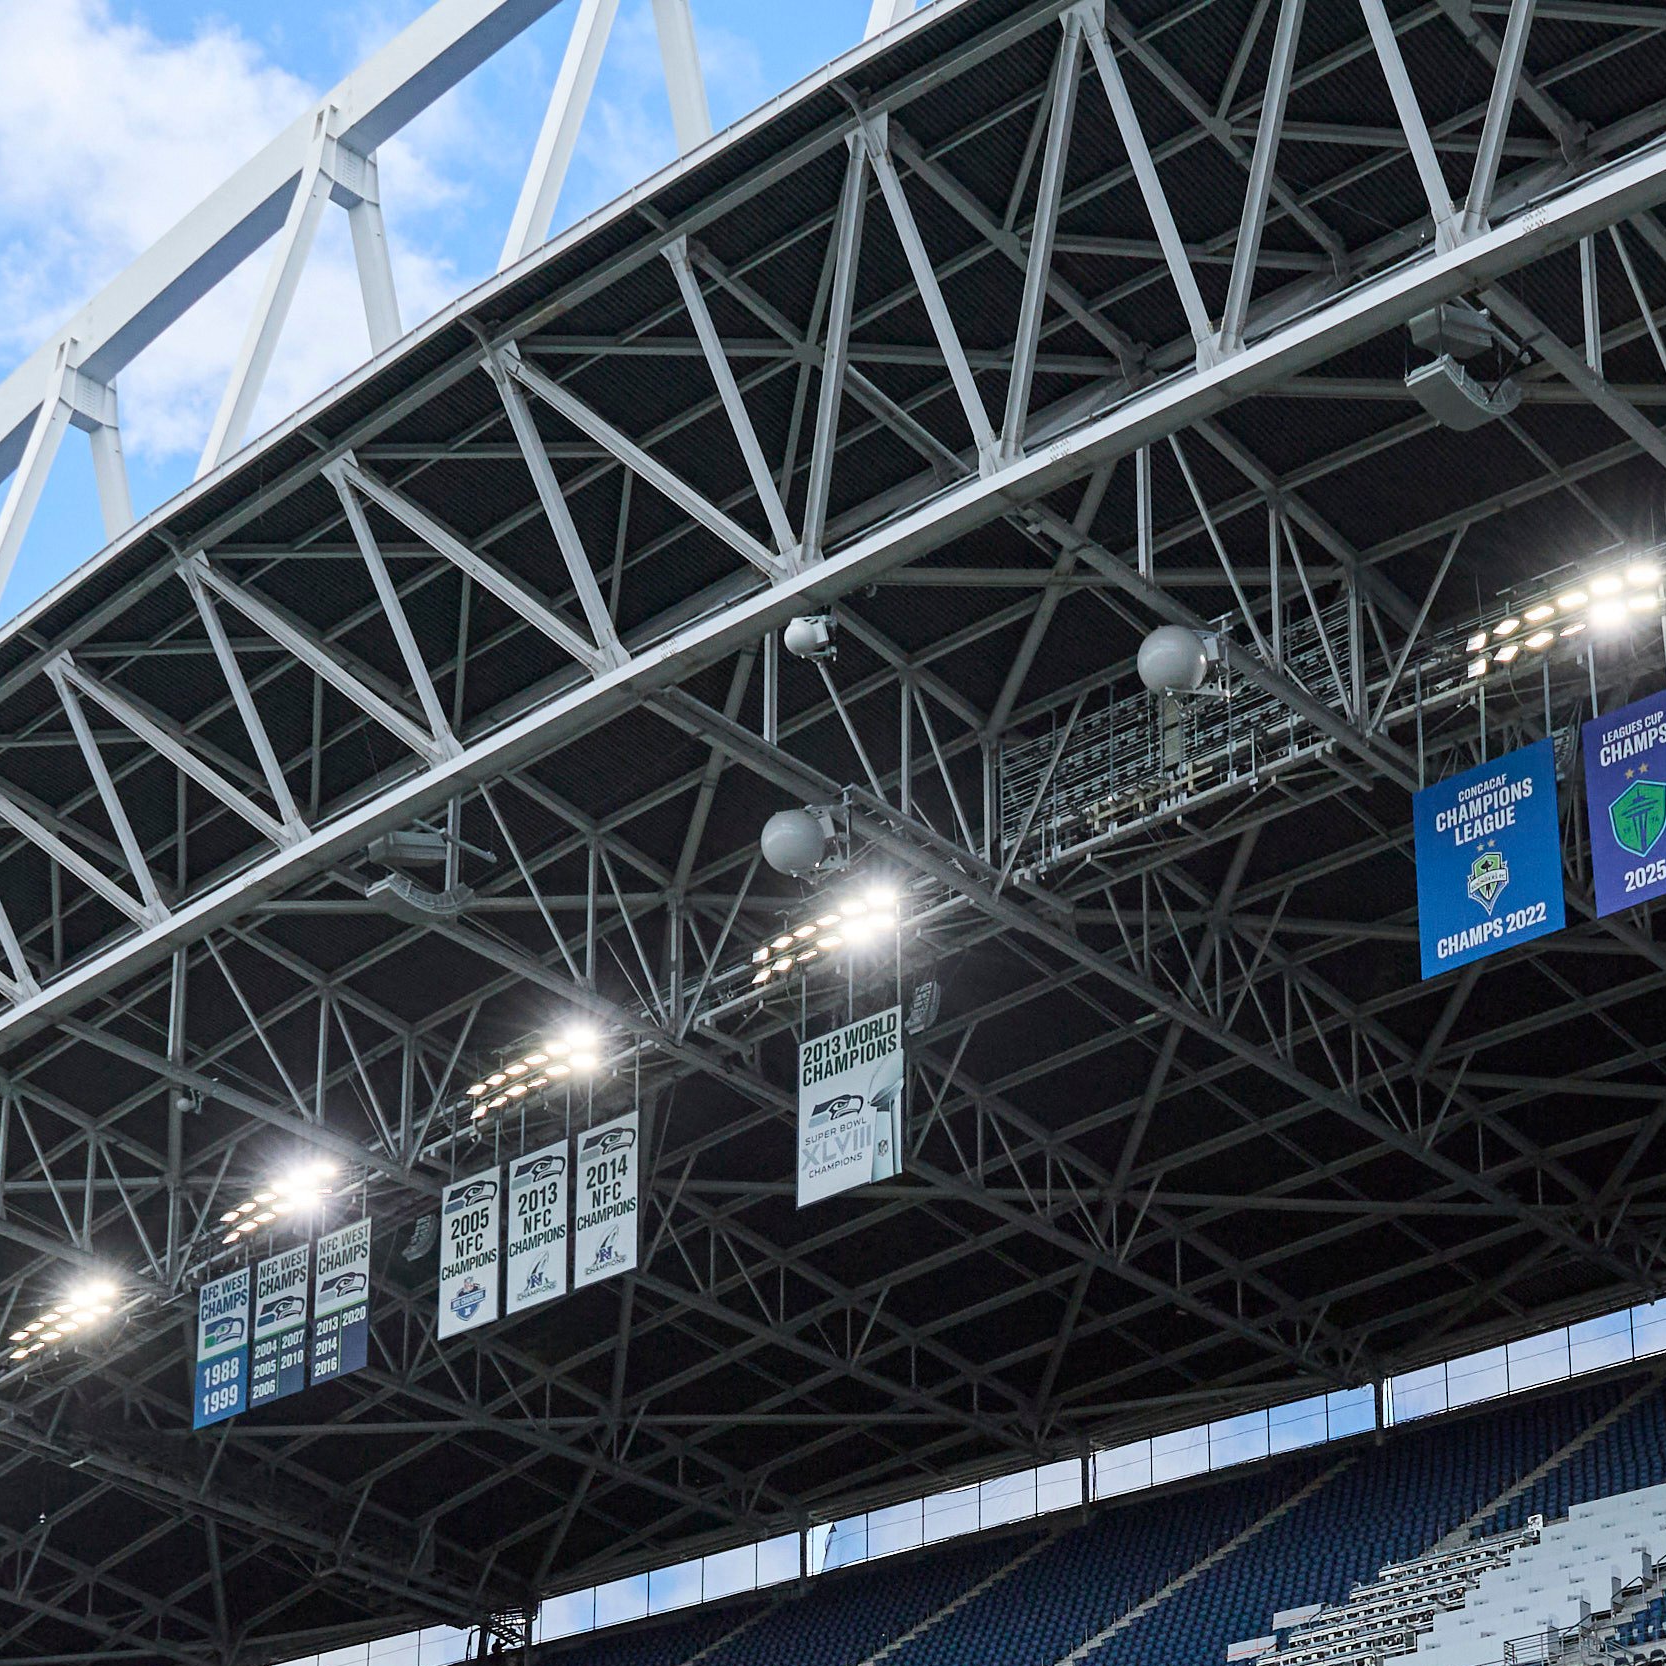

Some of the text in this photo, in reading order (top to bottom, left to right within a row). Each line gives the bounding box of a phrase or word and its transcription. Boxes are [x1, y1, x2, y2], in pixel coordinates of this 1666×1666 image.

[1602, 710, 1664, 746] LEAGUES CUP
[1458, 773, 1507, 802] CONCACAF
[1435, 777, 1533, 833] CHAMPIONS
[1454, 806, 1515, 847] LEAGUE
[1624, 859, 1666, 893] 2025
[1436, 902, 1547, 959] CHAMPS 2022
[803, 1012, 897, 1067] 2013 WORLD
[803, 1034, 897, 1087] CHAMPIONS
[805, 1117, 867, 1146] SUPER BOWL
[801, 1125, 872, 1172] XLVIII
[586, 1154, 628, 1190] 2014
[809, 1152, 863, 1179] CHAMPIONS
[518, 1182, 558, 1216] 2013
[592, 1181, 621, 1208] NFC
[451, 1207, 489, 1241] 2005
[523, 1208, 551, 1235] NFC
[577, 1197, 636, 1231] CHAMPIONS
[319, 1223, 370, 1256] NFC WEST
[455, 1233, 483, 1259] NFC
[509, 1224, 566, 1258] CHAMPIONS
[260, 1249, 307, 1279] NFC WEST
[318, 1241, 368, 1275] CHAMPS
[442, 1248, 497, 1281] CHAMPIONS
[201, 1273, 248, 1303] AFC WEST
[258, 1265, 307, 1299] CHAMPS
[201, 1289, 248, 1322] CHAMPS
[342, 1306, 366, 1326] 2020
[282, 1329, 305, 1349] 2007
[316, 1316, 338, 1337] 2013
[254, 1340, 277, 1360] 2004
[281, 1349, 303, 1370] 2010
[315, 1336, 338, 1357] 2014
[204, 1356, 239, 1389] 1988
[253, 1359, 277, 1380] 2005
[314, 1357, 338, 1377] 2016
[203, 1383, 238, 1416] 1999
[253, 1380, 276, 1400] 2006
